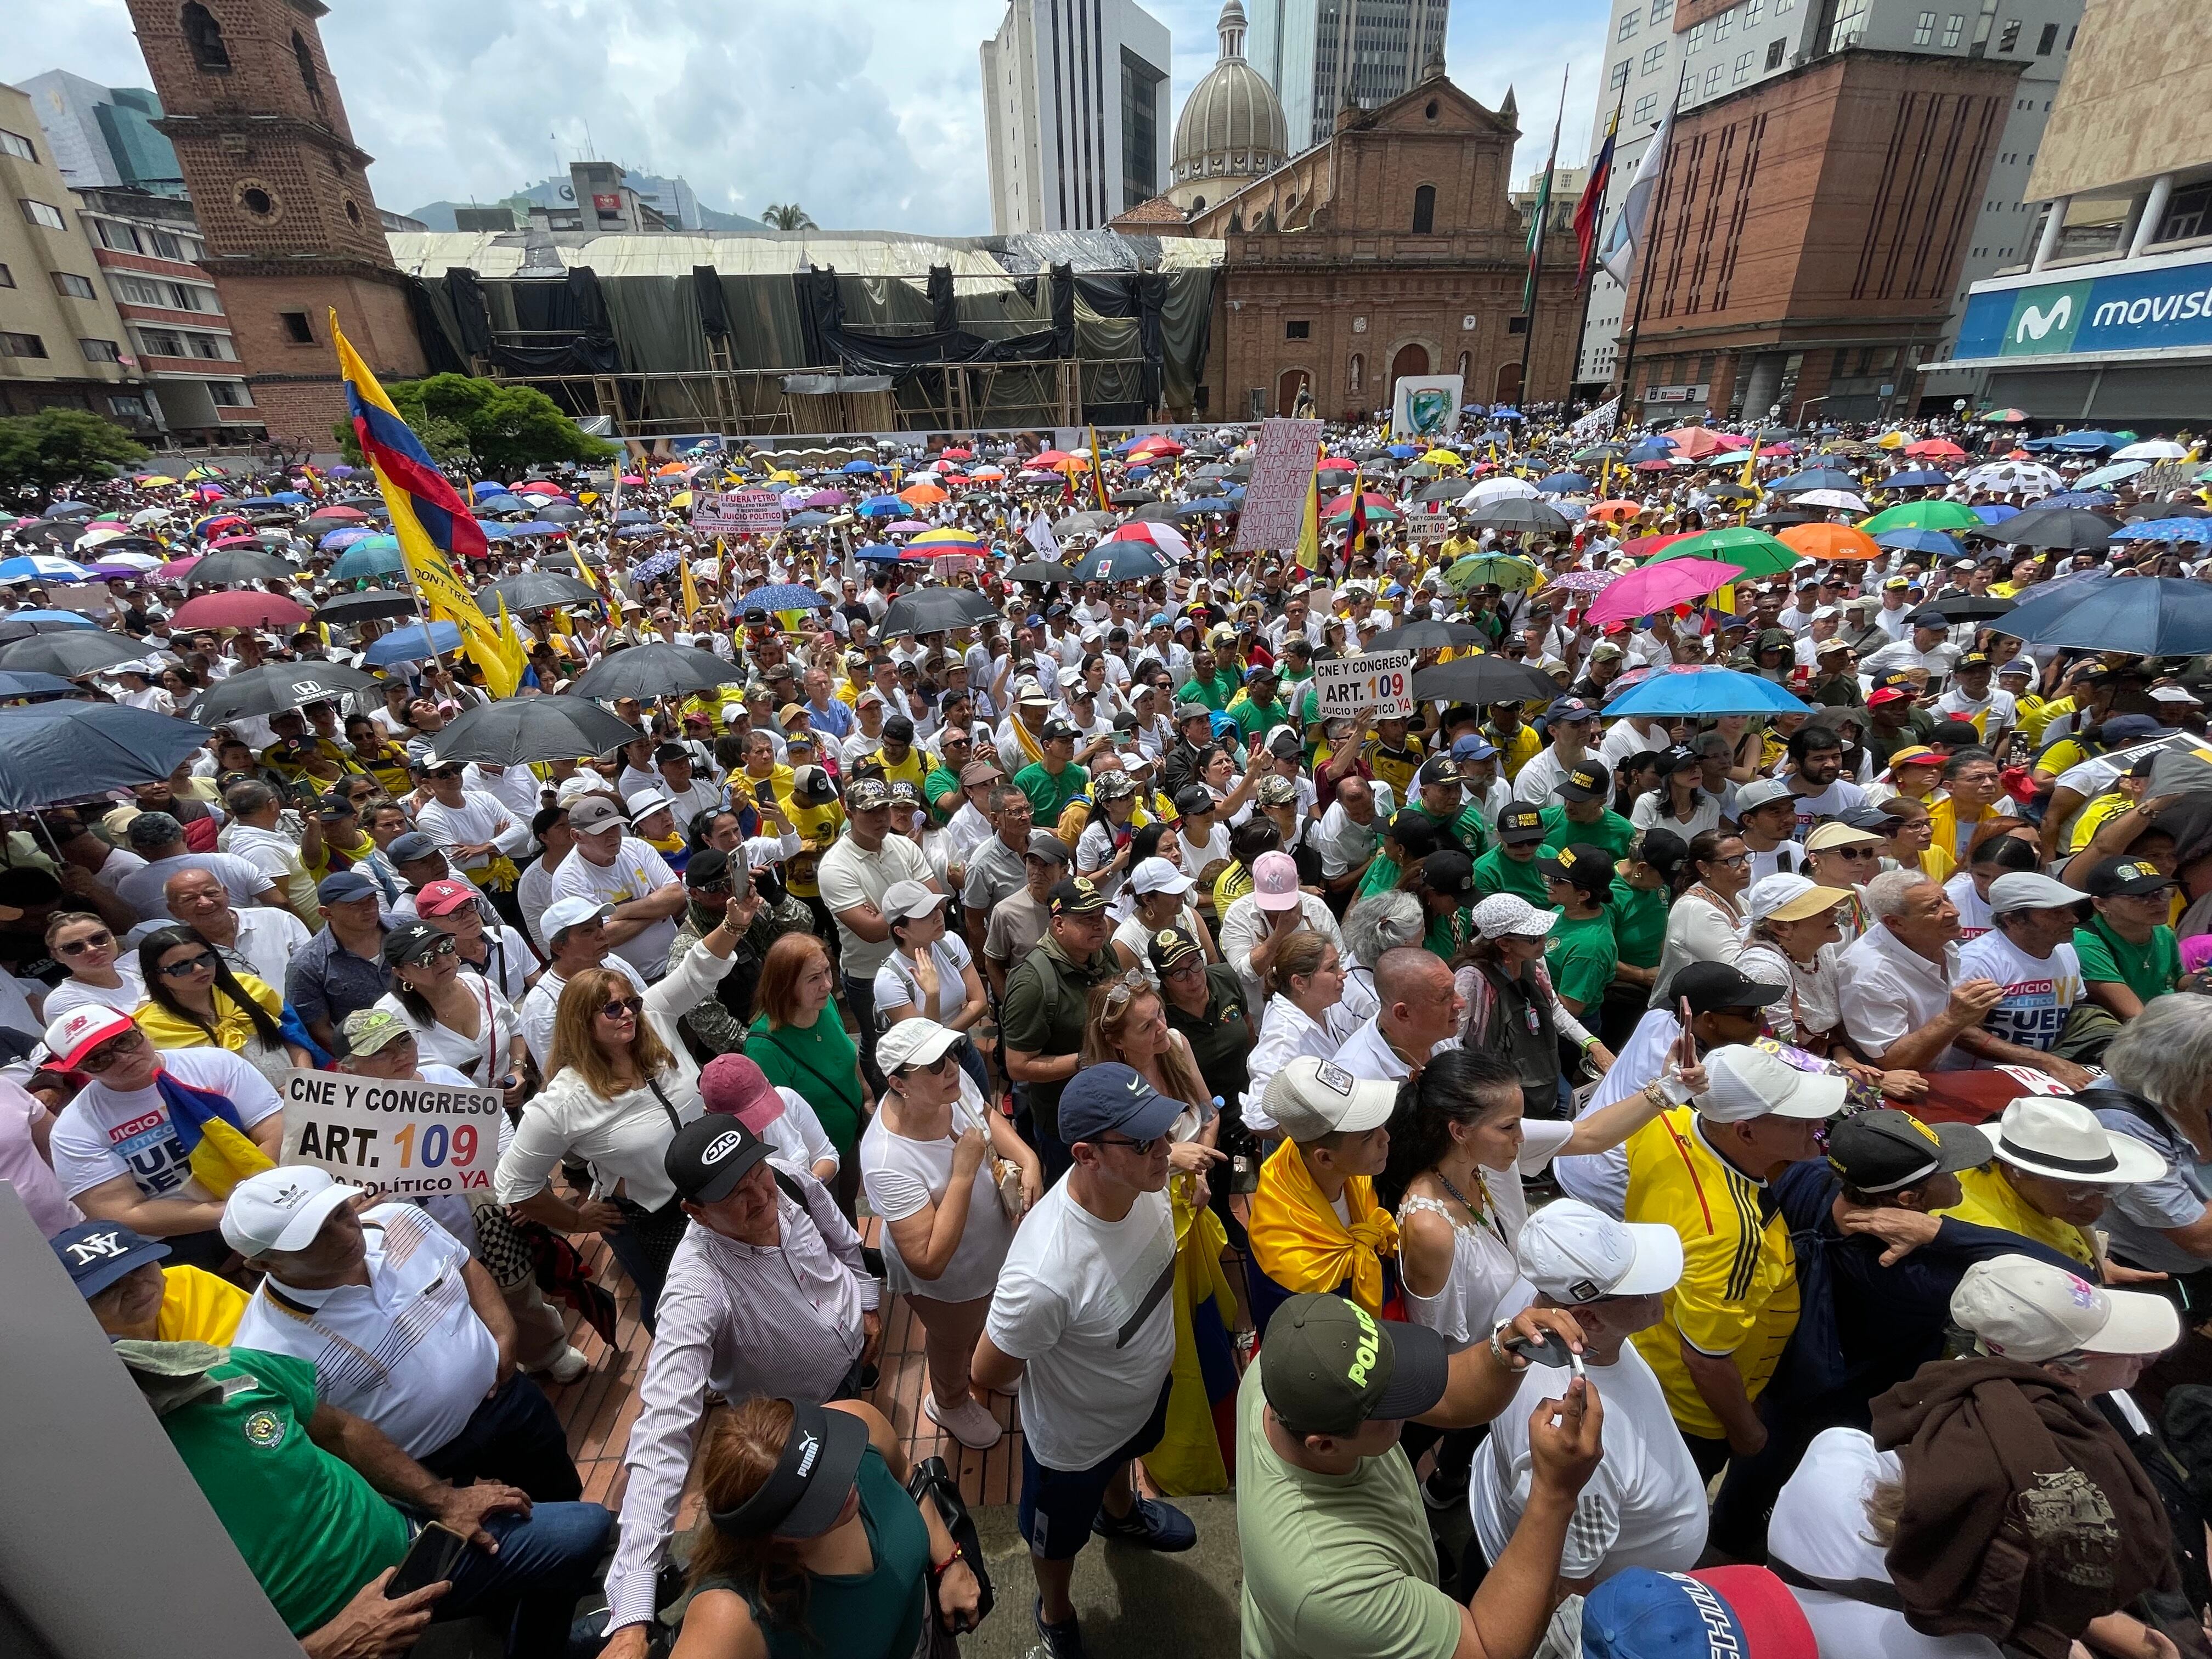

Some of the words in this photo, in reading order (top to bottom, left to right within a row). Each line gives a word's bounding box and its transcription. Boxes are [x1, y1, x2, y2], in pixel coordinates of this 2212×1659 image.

[726, 495, 751, 503] FUERA
[753, 494, 776, 503] PETRO
[1411, 524, 1427, 533] ART.
[1429, 522, 1445, 533] 109
[414, 567, 446, 587] DONT
[1318, 664, 1339, 677] CNE
[1342, 663, 1349, 675] Y
[1353, 655, 1409, 674] CONGRESO
[294, 689, 337, 703] HONDA
[1325, 682, 1363, 702] ART.
[1368, 673, 1403, 699] 109
[1322, 706, 1351, 715] JUICIO
[1396, 698, 1412, 712] YA
[291, 1077, 337, 1106] CNE
[344, 1084, 360, 1108] Y
[365, 1088, 498, 1115] CONGRESO
[298, 1121, 379, 1168] ART.
[393, 1123, 478, 1168] 109
[707, 1133, 736, 1160] JAC
[459, 1170, 490, 1189] YA
[286, 1189, 309, 1210] adidas
[66, 1232, 129, 1266] NY
[797, 1441, 820, 1478] PUMA
